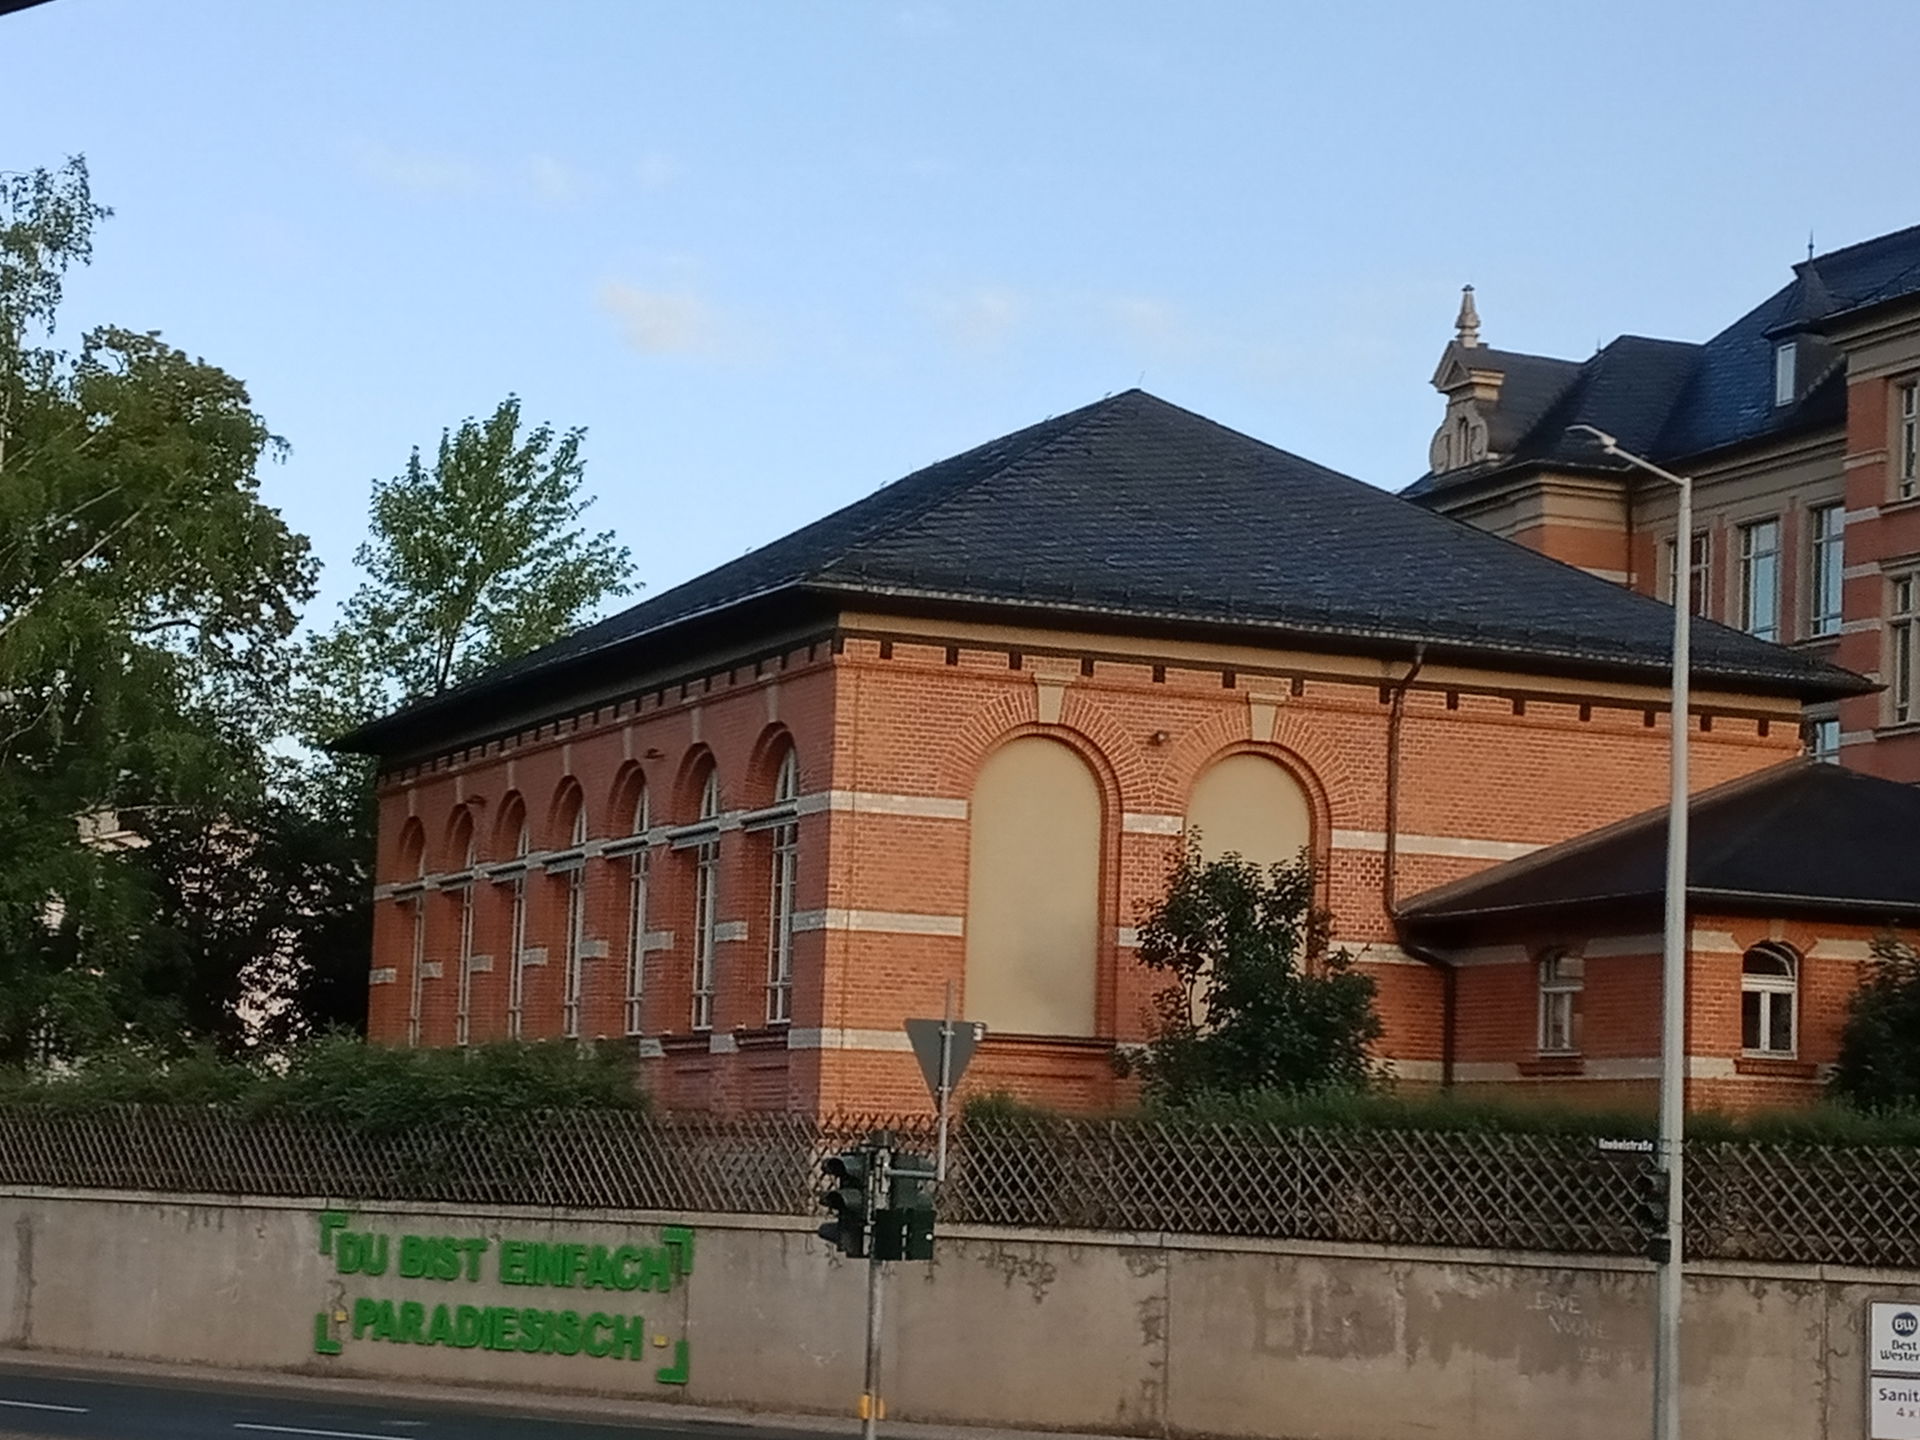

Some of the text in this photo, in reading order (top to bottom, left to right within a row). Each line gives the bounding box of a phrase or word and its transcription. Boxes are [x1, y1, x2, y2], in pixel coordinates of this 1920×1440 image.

[336, 1231, 671, 1292] DU BIST EINFACH
[352, 1298, 645, 1361] PARADIESISCH
[1891, 1340, 1918, 1351] Best
[1879, 1387, 1920, 1402] Sanit
